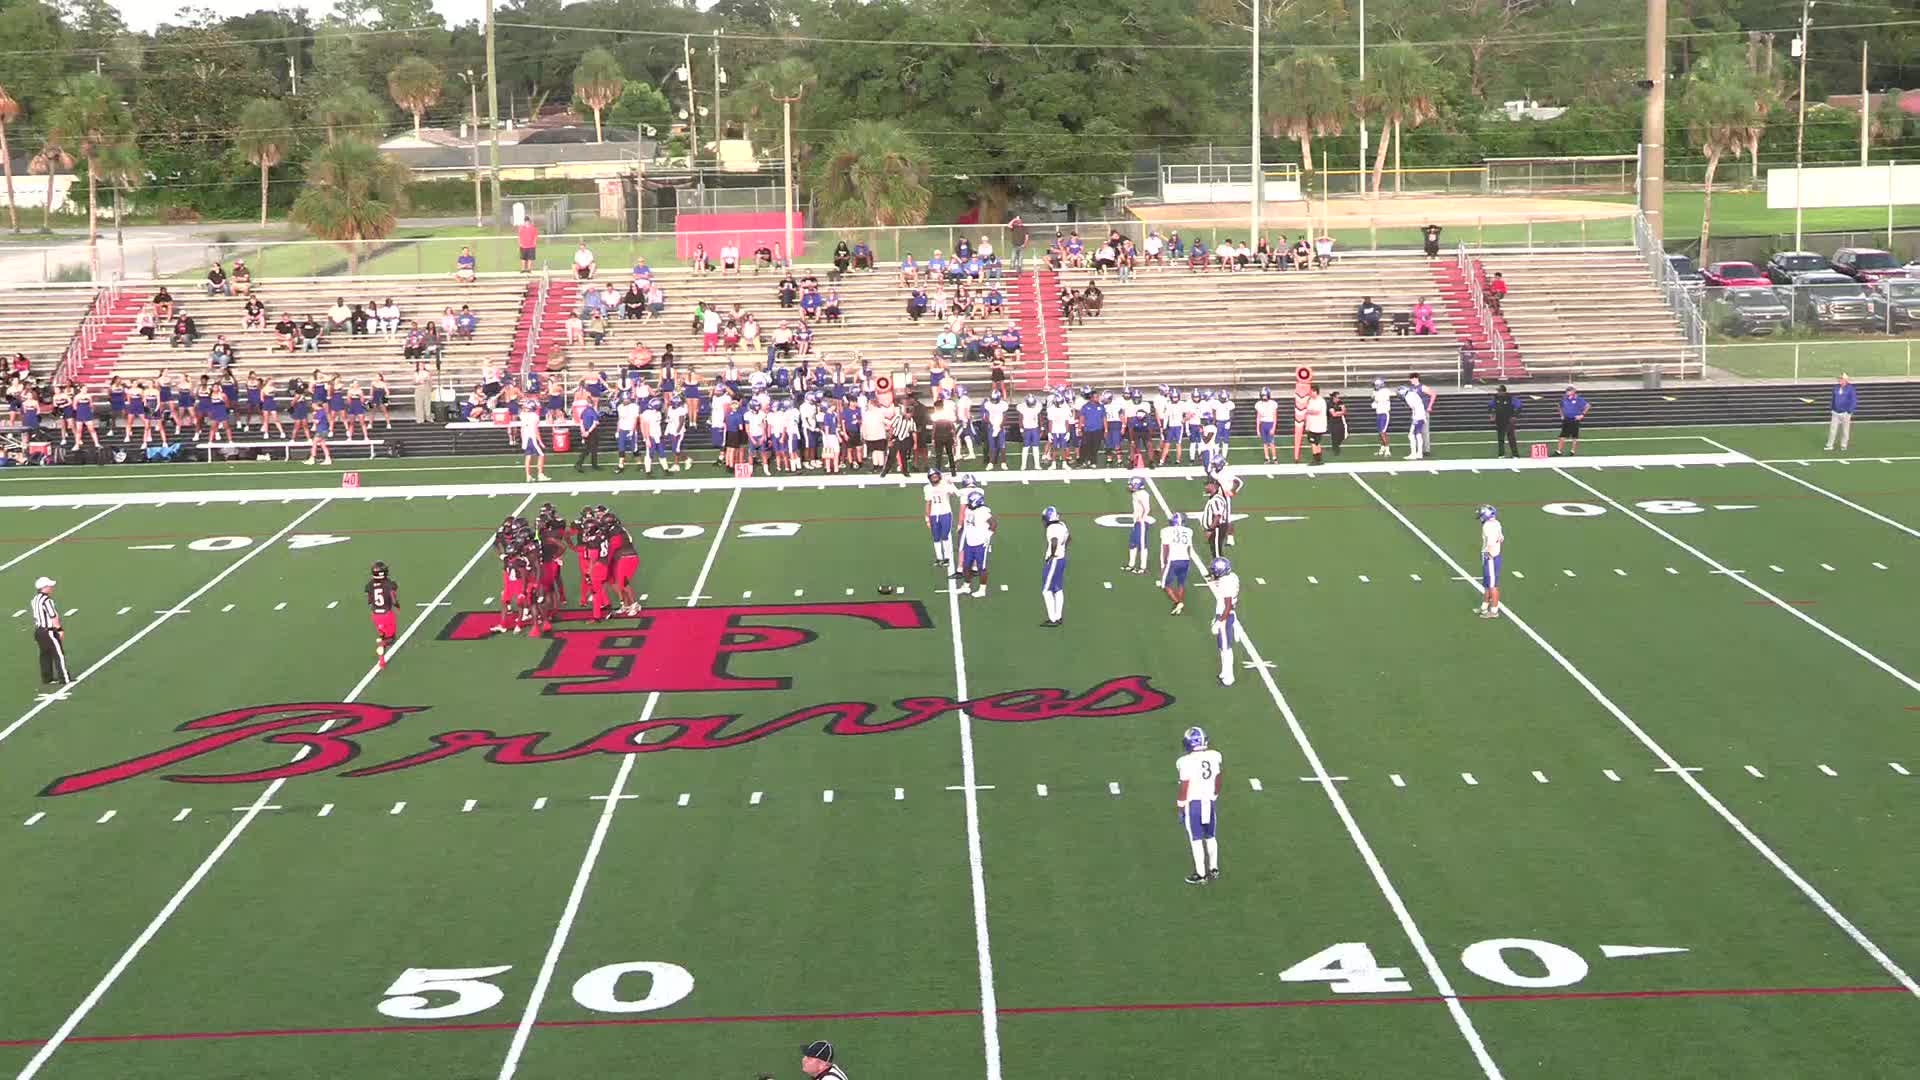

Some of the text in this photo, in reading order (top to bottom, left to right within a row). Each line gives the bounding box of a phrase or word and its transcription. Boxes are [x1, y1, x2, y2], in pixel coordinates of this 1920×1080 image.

[374, 588, 385, 606] 5
[36, 676, 1176, 797] Braves
[1202, 760, 1212, 779] 3
